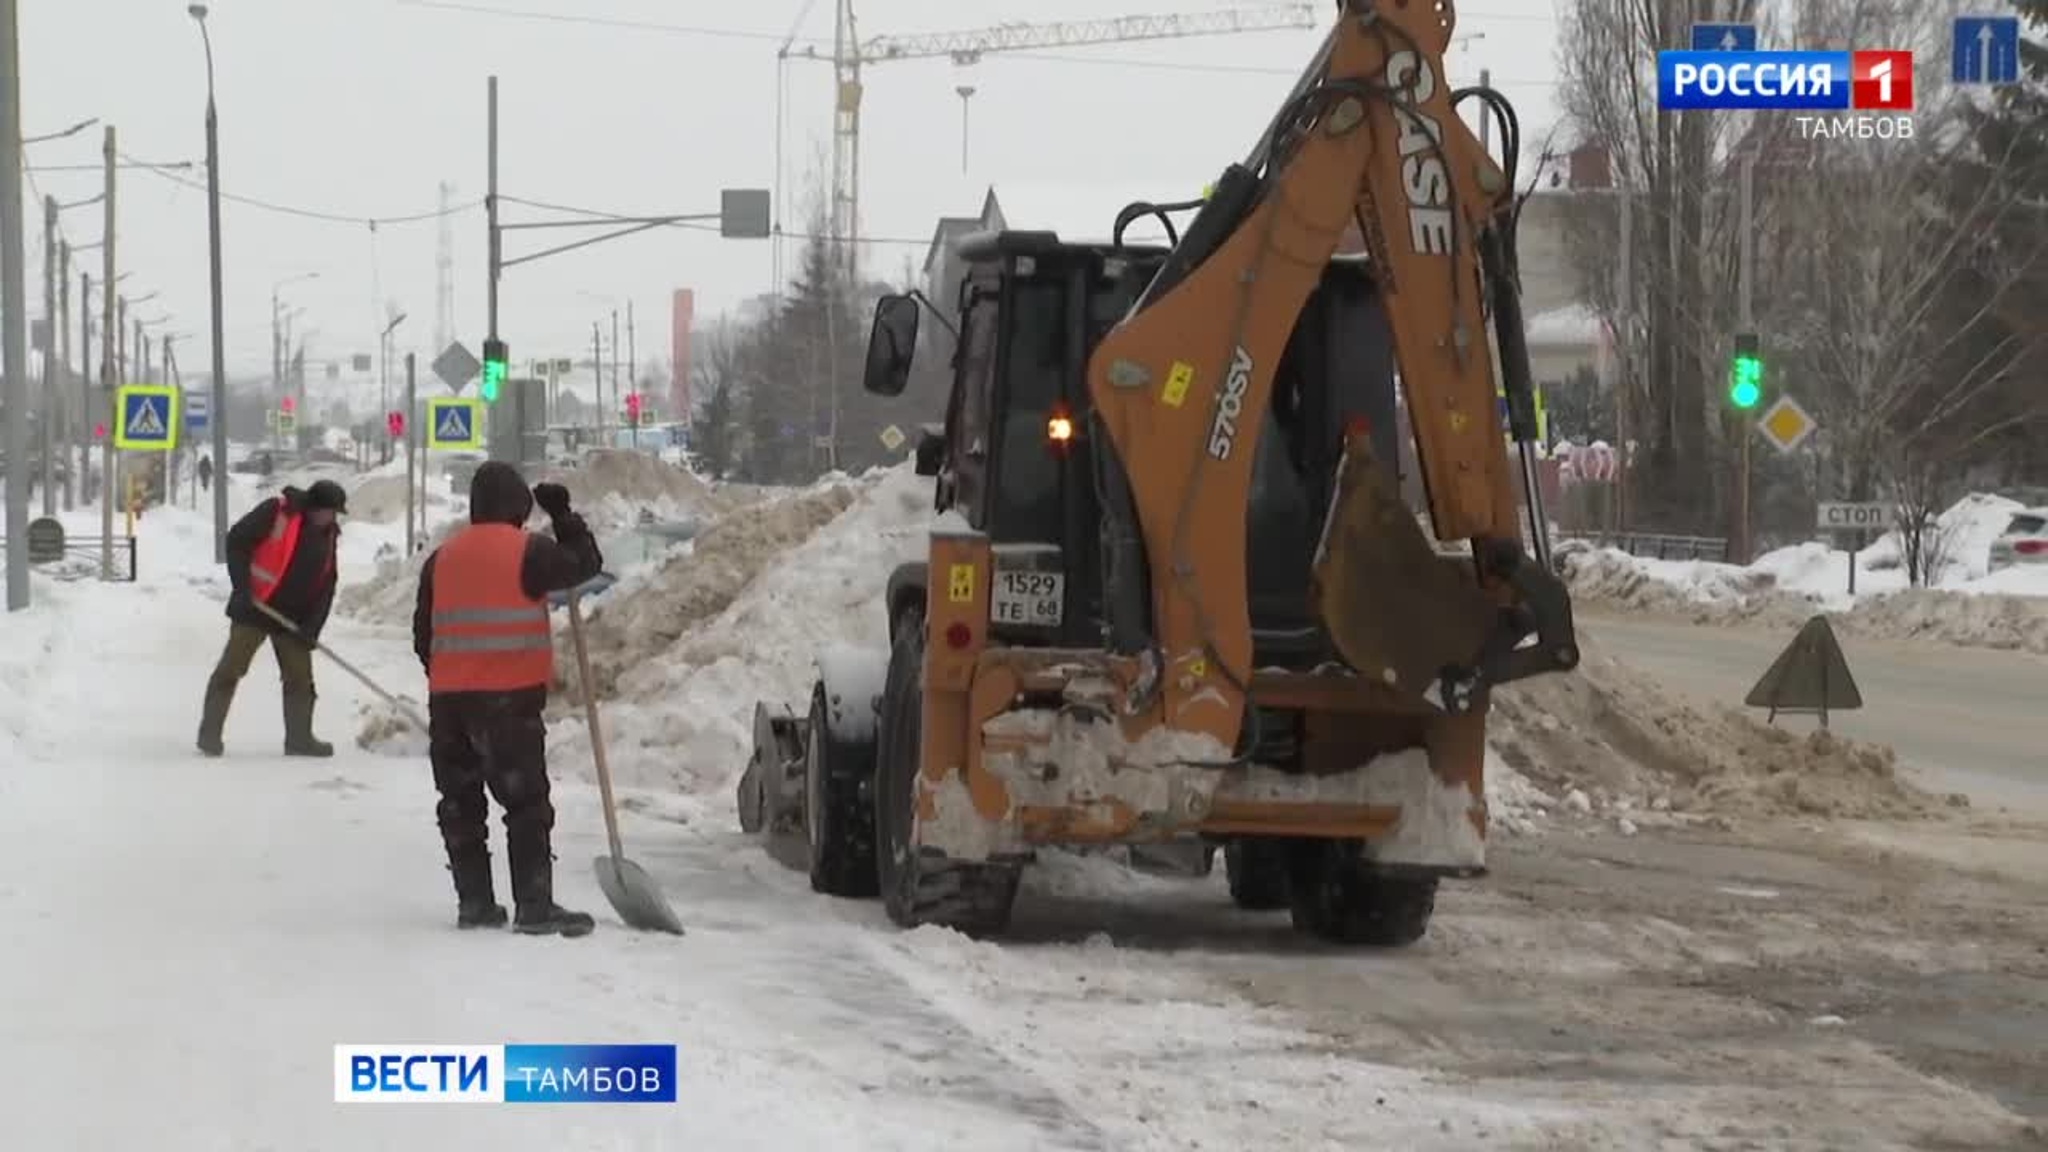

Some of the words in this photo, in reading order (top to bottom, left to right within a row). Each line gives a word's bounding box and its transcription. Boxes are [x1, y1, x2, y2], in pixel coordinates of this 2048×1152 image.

[1386, 50, 1452, 255] CASE
[1828, 506, 1881, 524] СТОП
[1003, 573, 1056, 595] 1529
[998, 601, 1024, 620] ТЕ
